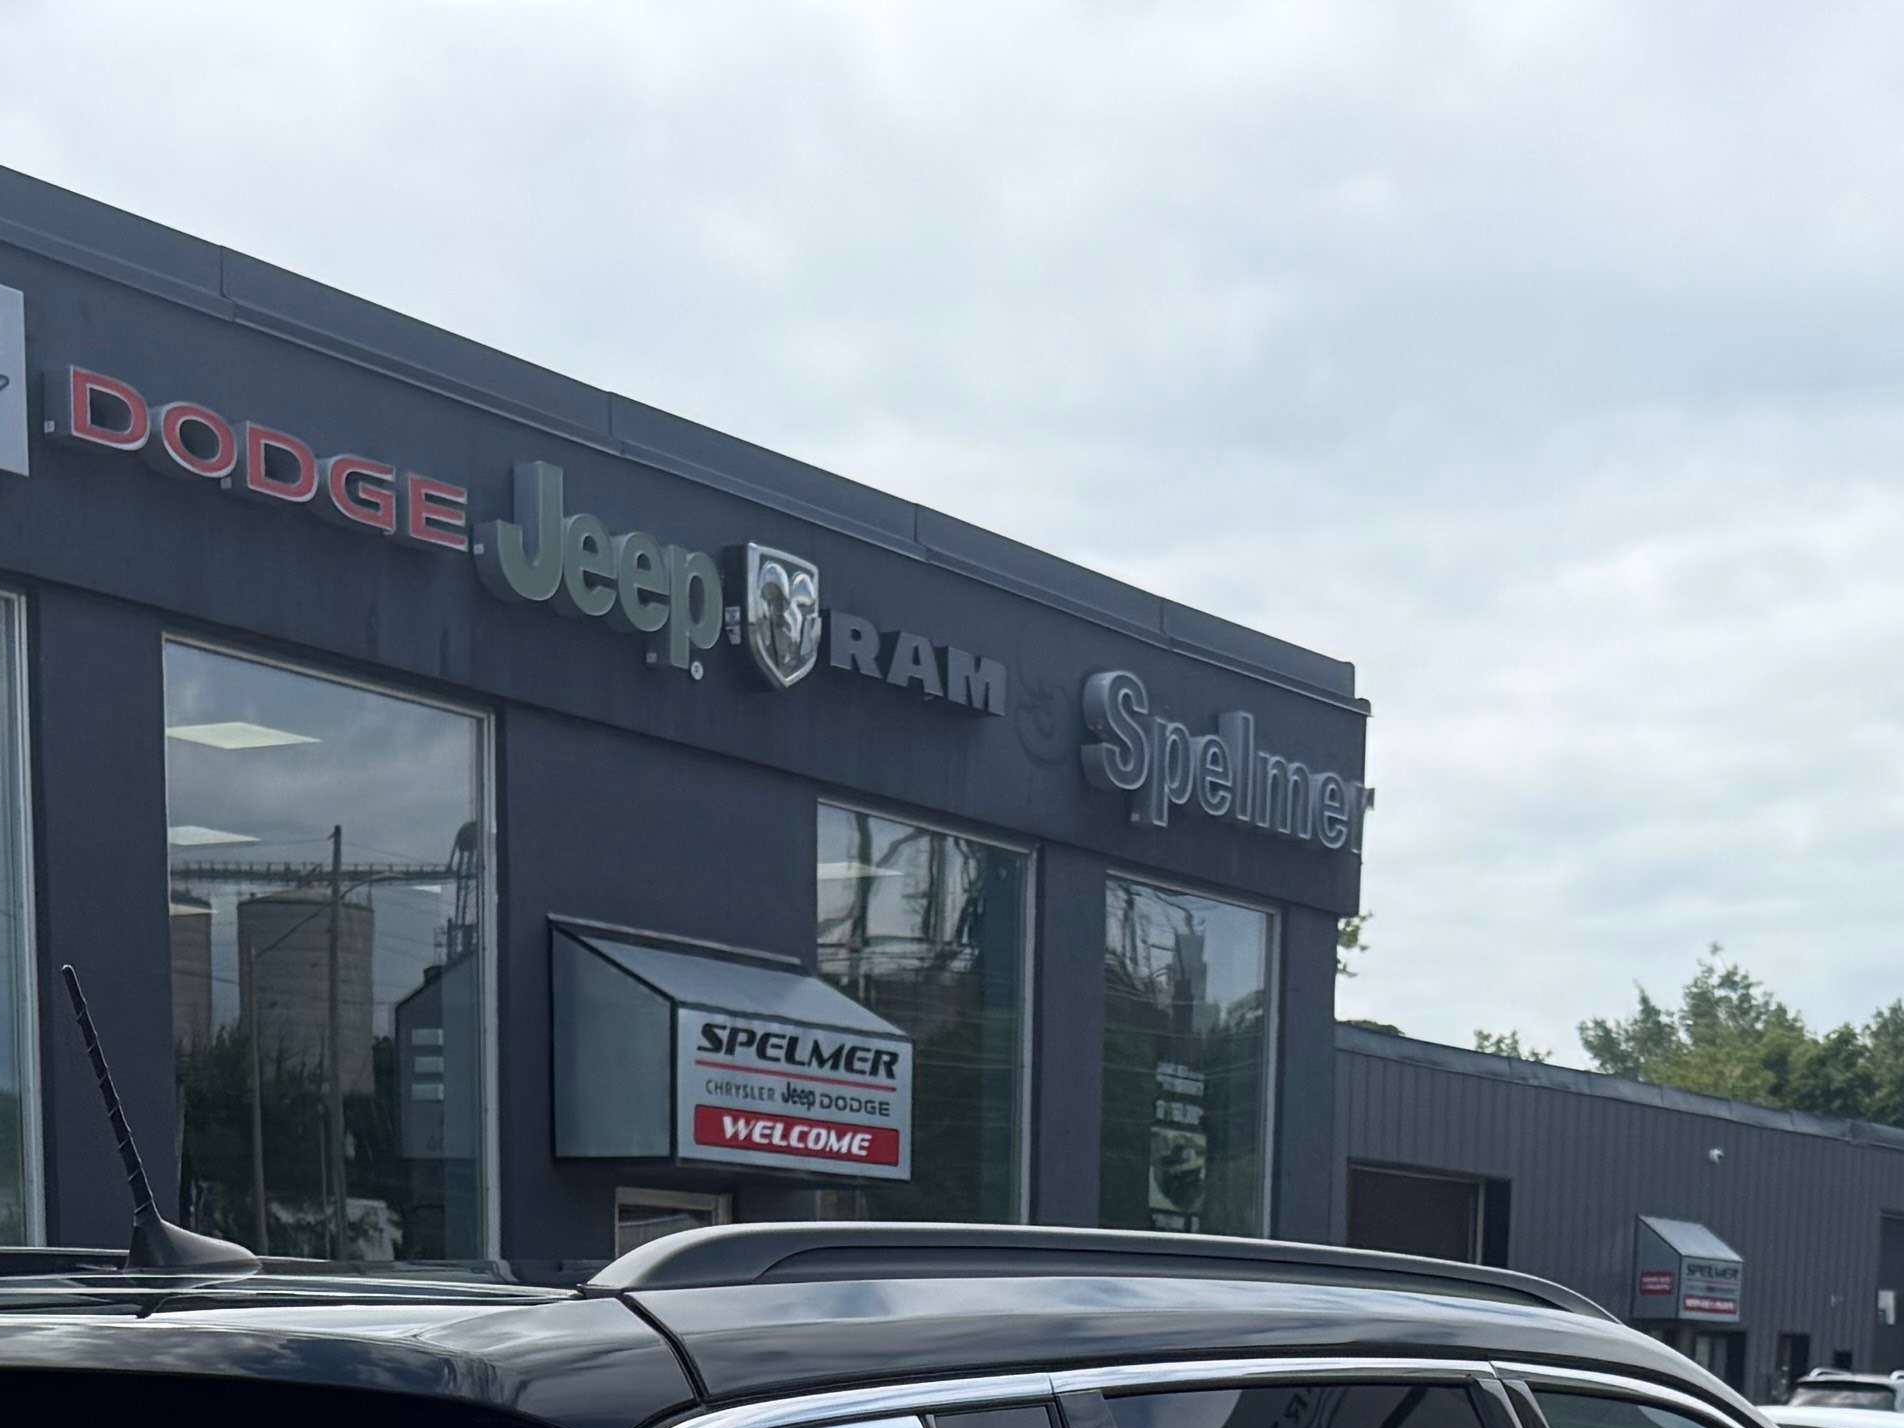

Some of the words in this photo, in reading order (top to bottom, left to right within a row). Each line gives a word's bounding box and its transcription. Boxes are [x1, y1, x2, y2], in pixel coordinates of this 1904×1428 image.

[69, 366, 468, 552] DODGE
[476, 460, 723, 670] Jeep
[828, 608, 1008, 717] RAM
[1081, 671, 1374, 853] Spelmer
[697, 1022, 900, 1080] SPELMER
[705, 1079, 776, 1102] CHRYSLER
[781, 1081, 816, 1112] Jeep
[819, 1093, 892, 1117] DODGE
[722, 1115, 873, 1156] WELCOME
